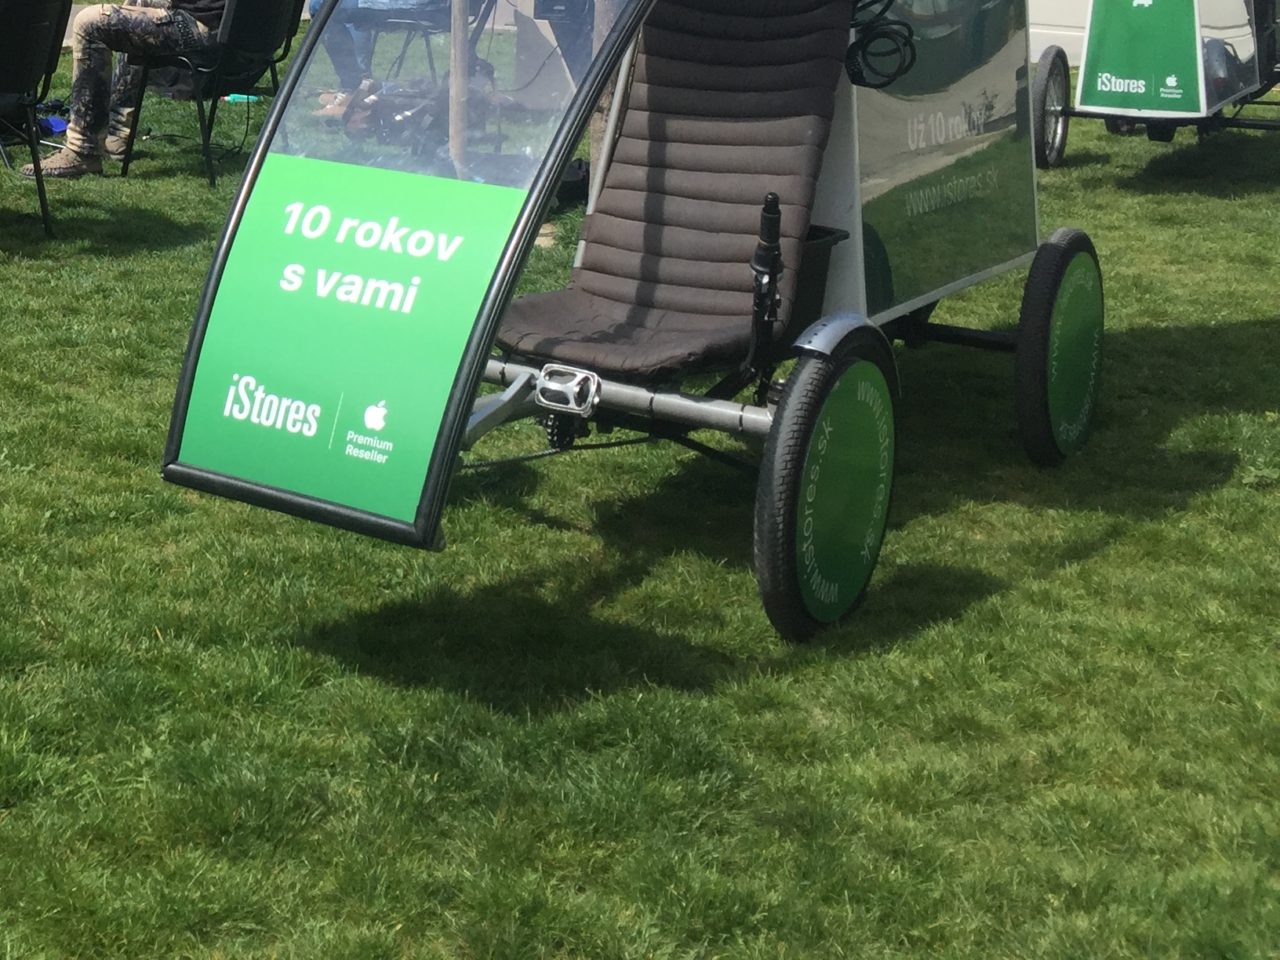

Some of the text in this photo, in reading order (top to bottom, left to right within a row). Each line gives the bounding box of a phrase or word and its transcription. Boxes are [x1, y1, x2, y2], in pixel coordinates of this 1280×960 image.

[1097, 72, 1146, 94] iStores
[928, 111, 946, 145] 10
[282, 201, 464, 262] 10 rokov
[279, 262, 421, 314] s vami
[223, 373, 322, 437] iStores
[344, 444, 389, 465] Reseller
[346, 430, 394, 452] Premium
